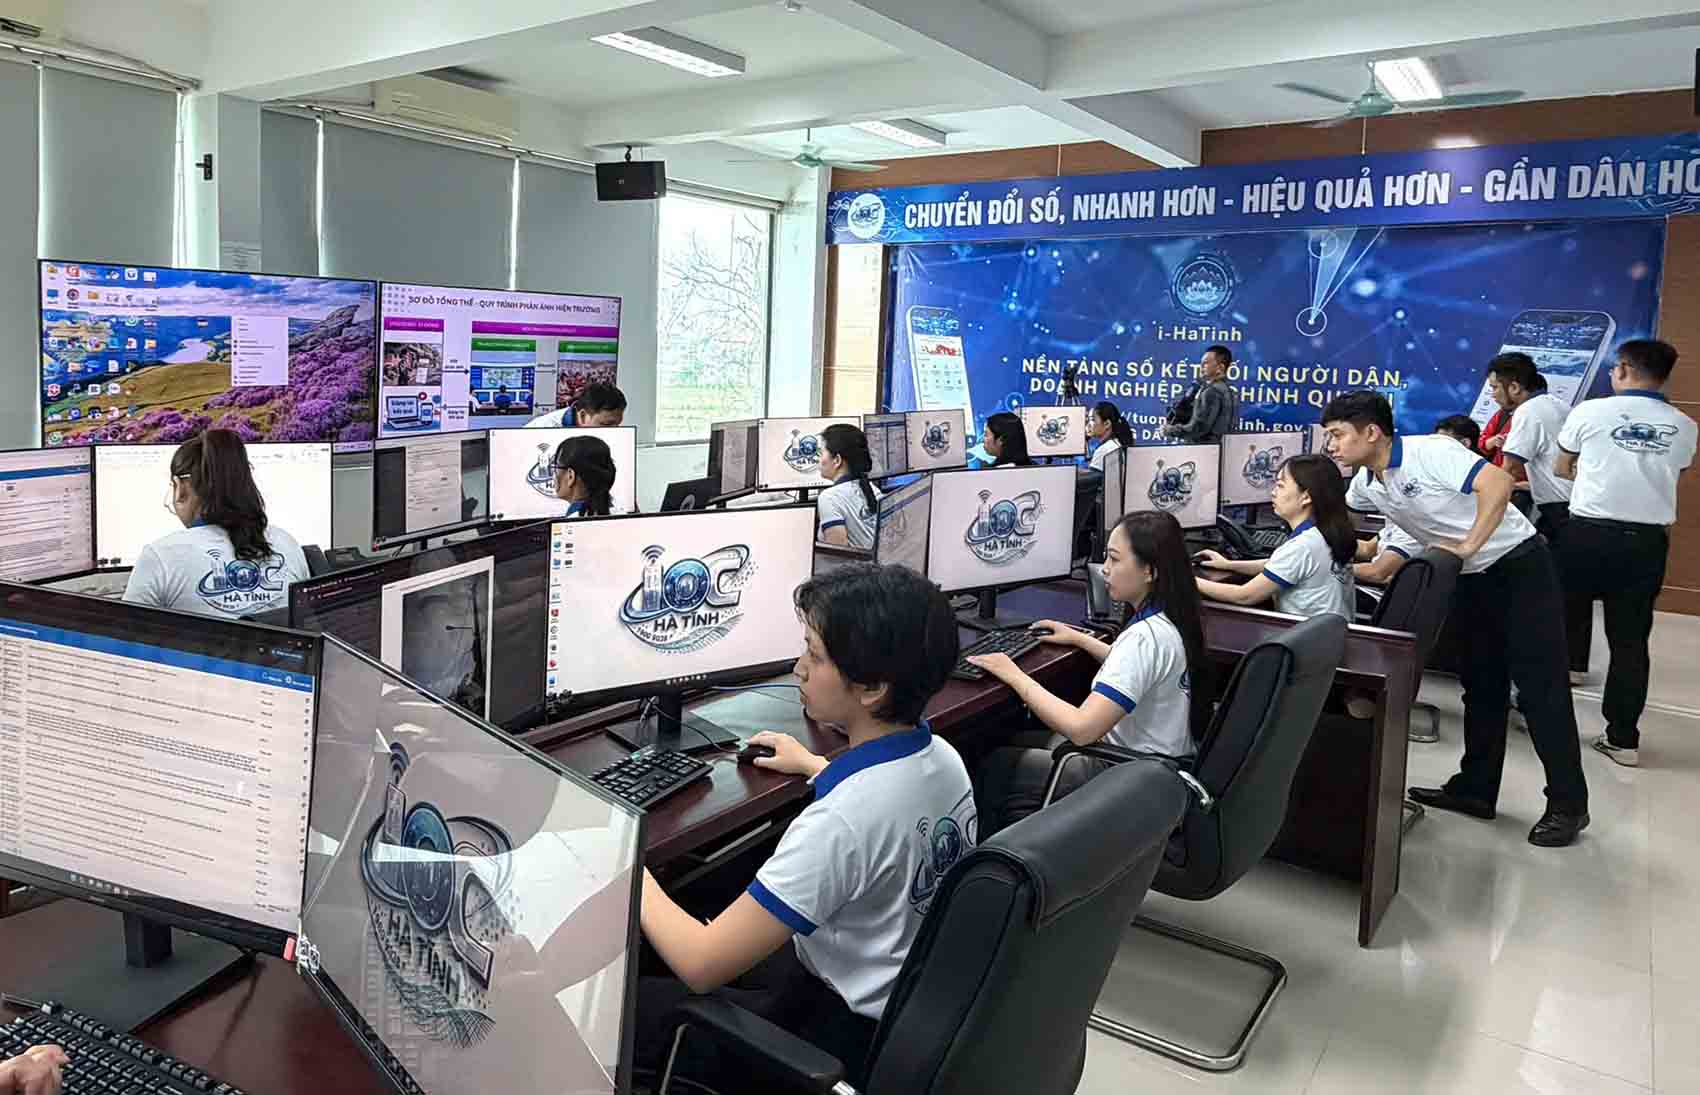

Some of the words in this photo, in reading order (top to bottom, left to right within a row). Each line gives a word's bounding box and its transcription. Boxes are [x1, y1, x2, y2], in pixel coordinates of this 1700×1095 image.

[904, 191, 982, 229] CHUYỂN
[988, 188, 1024, 225] ĐỔI
[1030, 186, 1065, 225] SỐ,
[1072, 190, 1156, 221] NHANH
[1162, 185, 1216, 218] HƠN
[1242, 177, 1306, 218] HIỆU
[1315, 167, 1374, 213] QUẢ
[1383, 171, 1451, 207] HƠN
[1484, 157, 1557, 203] GẦN
[1567, 156, 1646, 198] DÂN
[1158, 326, 1242, 341] i-HaTinh
[1022, 353, 1060, 374] NỀN
[1126, 357, 1154, 377] SỐ
[1161, 358, 1201, 379] KẾT
[1257, 363, 1338, 385] NGƯỜI
[1347, 366, 1408, 390] DÂN,
[1104, 380, 1184, 403] NGHIỆP
[654, 613, 678, 632] HÀ
